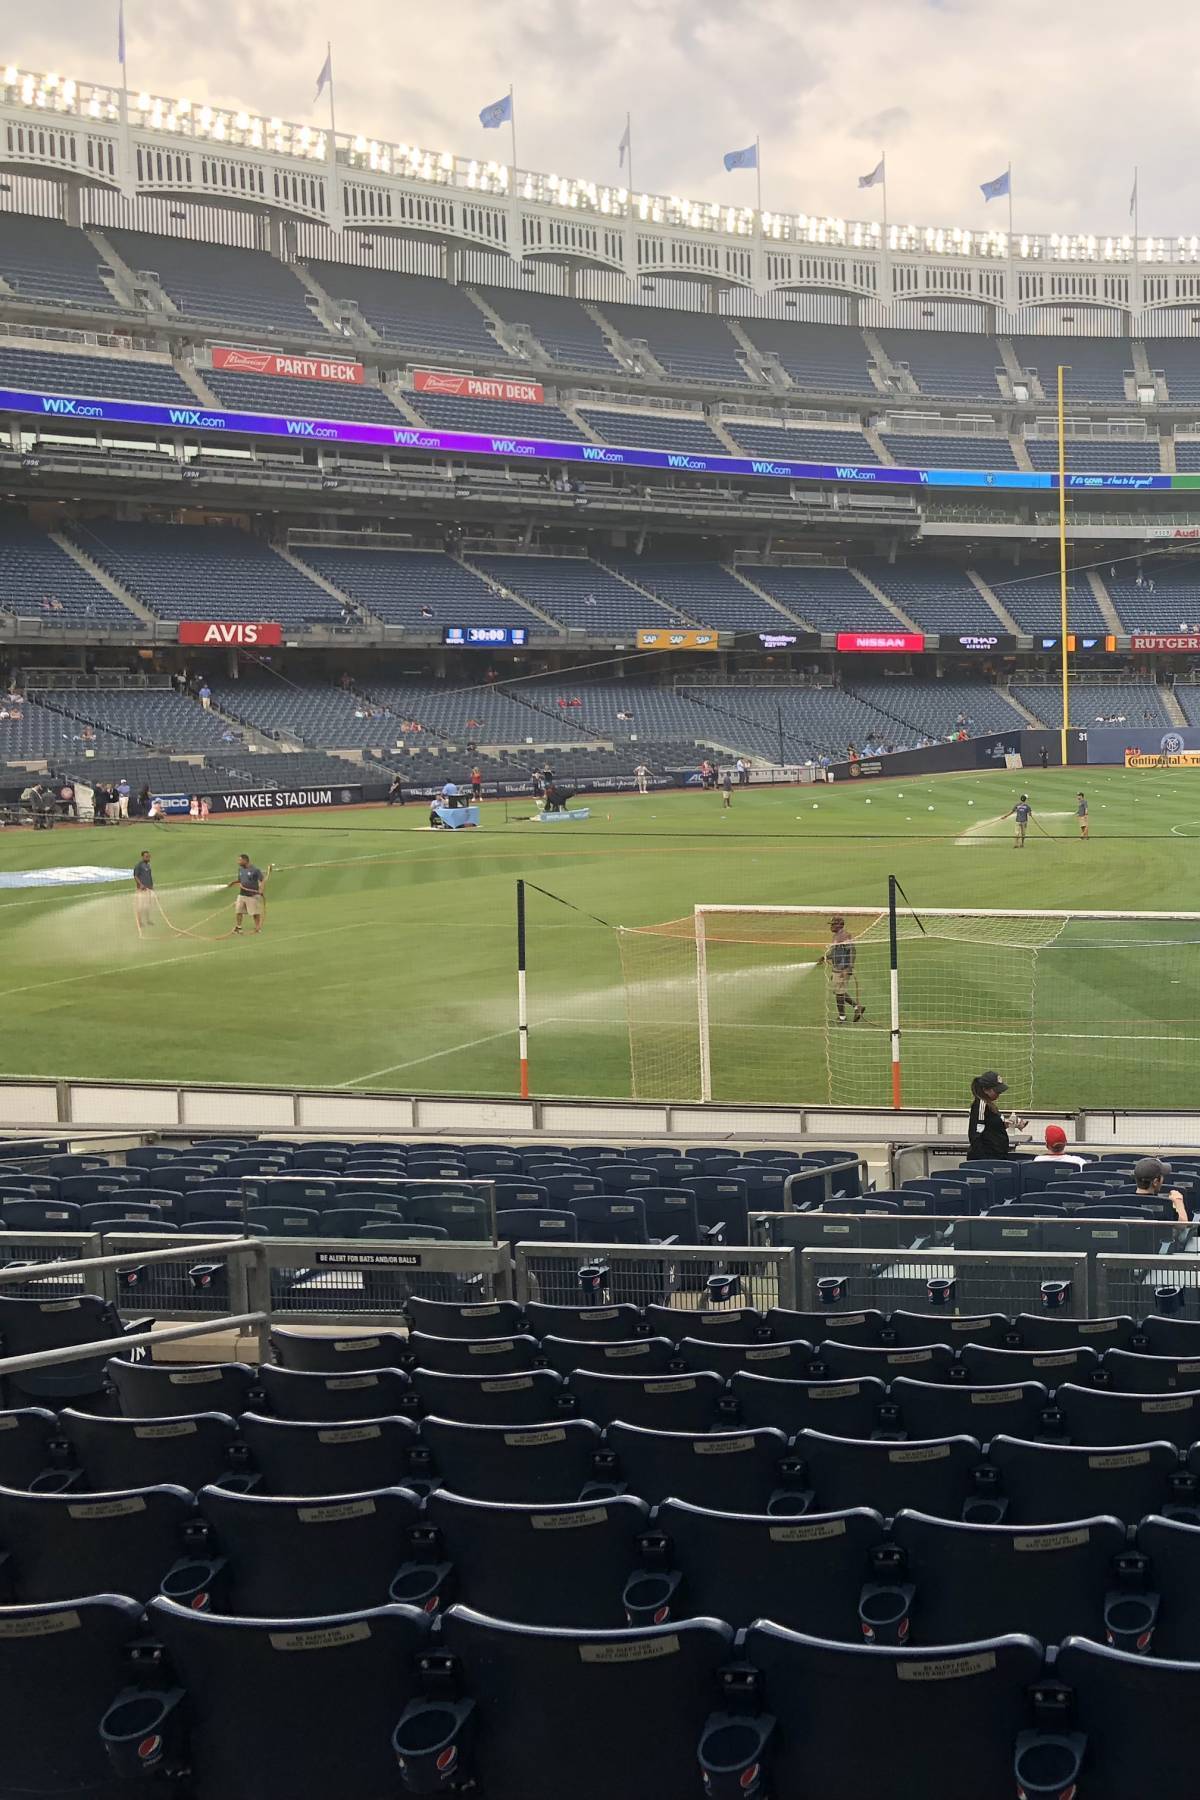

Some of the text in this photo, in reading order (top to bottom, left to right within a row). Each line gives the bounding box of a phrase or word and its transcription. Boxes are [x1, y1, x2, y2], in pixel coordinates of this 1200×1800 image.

[276, 358, 317, 377] PARTY
[320, 363, 356, 381] DECK
[468, 380, 503, 397] PARTY
[505, 384, 537, 400] DECK
[1175, 529, 1200, 538] Audi
[204, 624, 258, 643] AVIS
[959, 636, 998, 645] ETIHAD
[856, 638, 905, 648] NISSAN
[223, 791, 332, 809] YANKEE STADIUM
